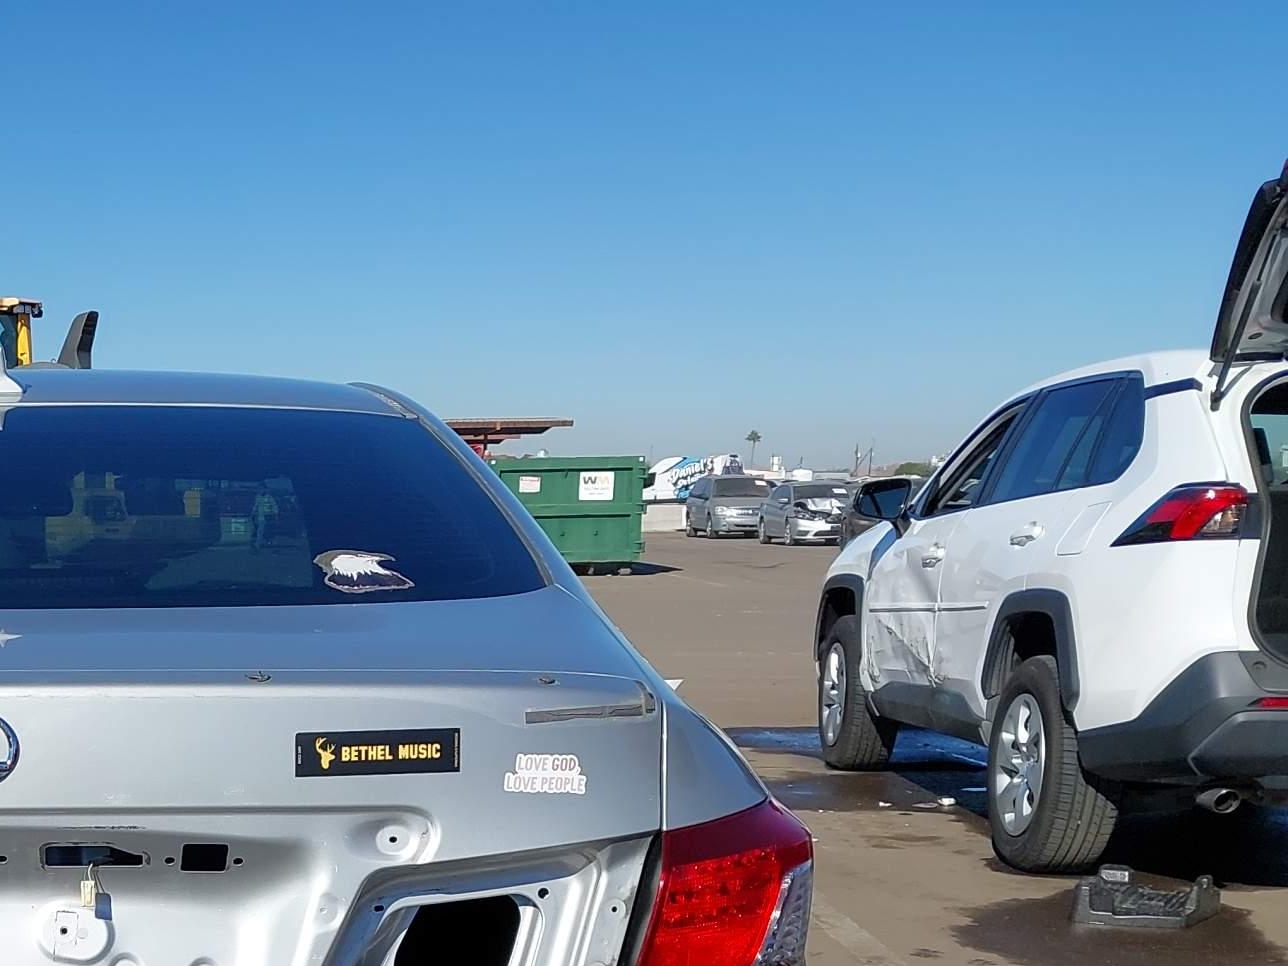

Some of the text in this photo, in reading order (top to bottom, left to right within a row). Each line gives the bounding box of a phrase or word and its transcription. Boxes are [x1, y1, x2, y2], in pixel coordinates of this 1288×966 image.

[341, 745, 393, 762] BETHEL
[398, 743, 441, 760] MUSIC
[518, 756, 580, 773] LOVE GOD,
[506, 775, 585, 792] LOVE PEOPLE
